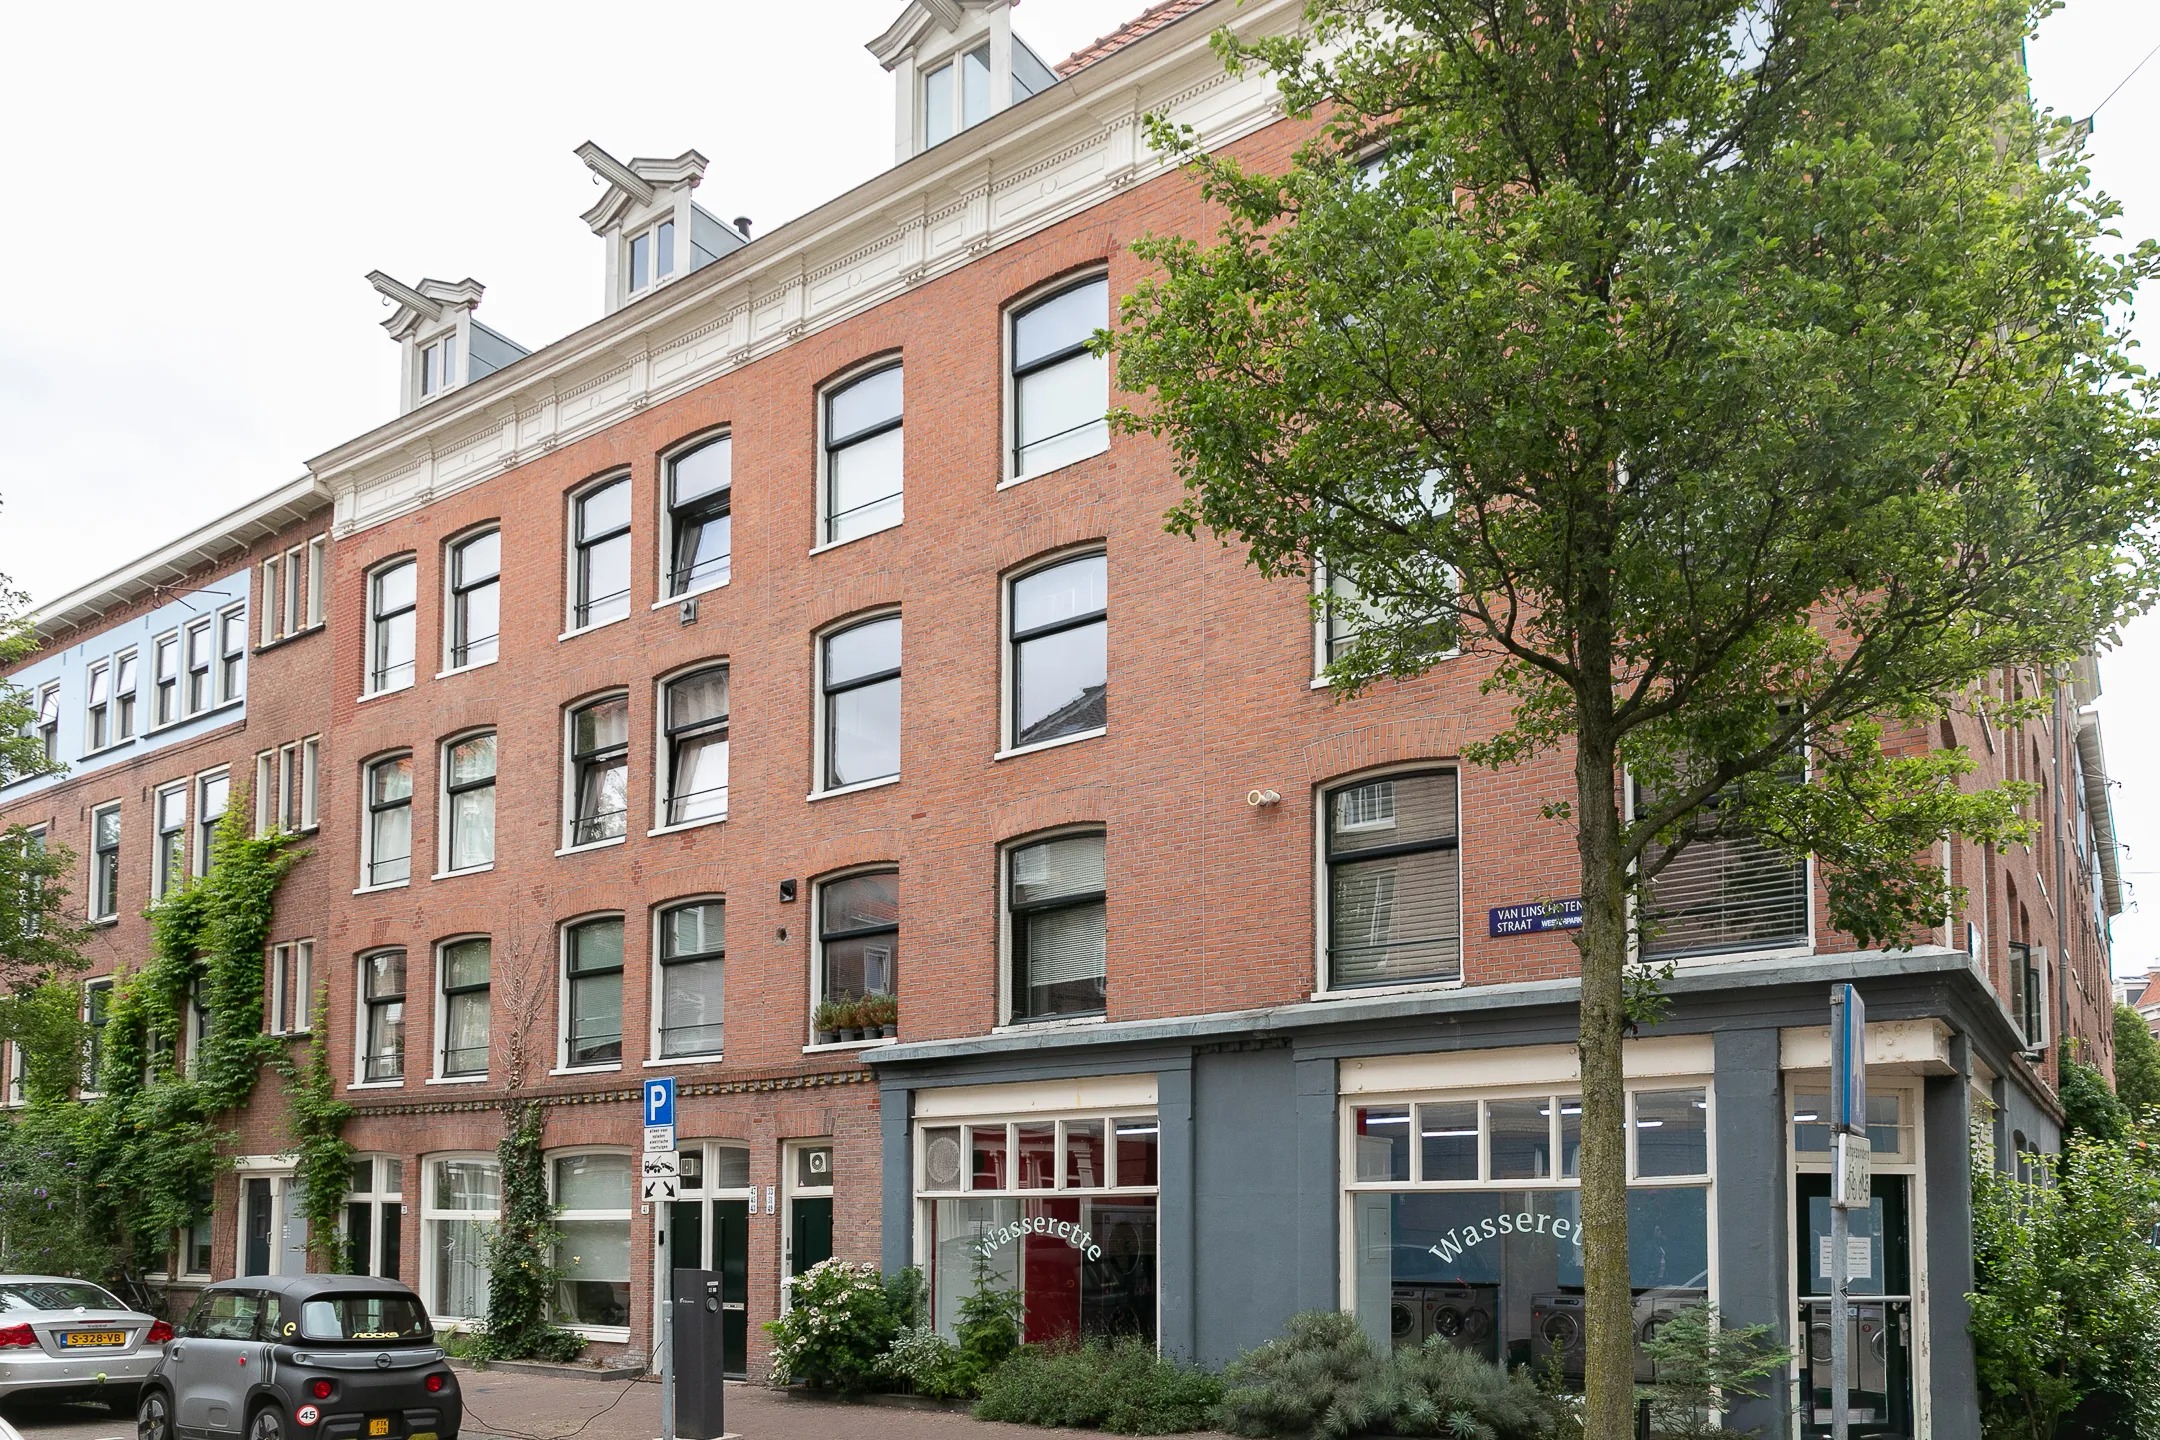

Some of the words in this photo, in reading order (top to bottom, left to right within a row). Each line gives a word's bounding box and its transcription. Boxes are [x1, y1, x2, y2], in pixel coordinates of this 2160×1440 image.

[1497, 908, 1518, 920] VAN
[1497, 918, 1533, 933] STRAAT
[650, 1084, 667, 1121] P
[974, 1216, 1102, 1262] Wasserette
[72, 1333, 121, 1344] S-328-VB
[301, 1411, 316, 1420] 45
